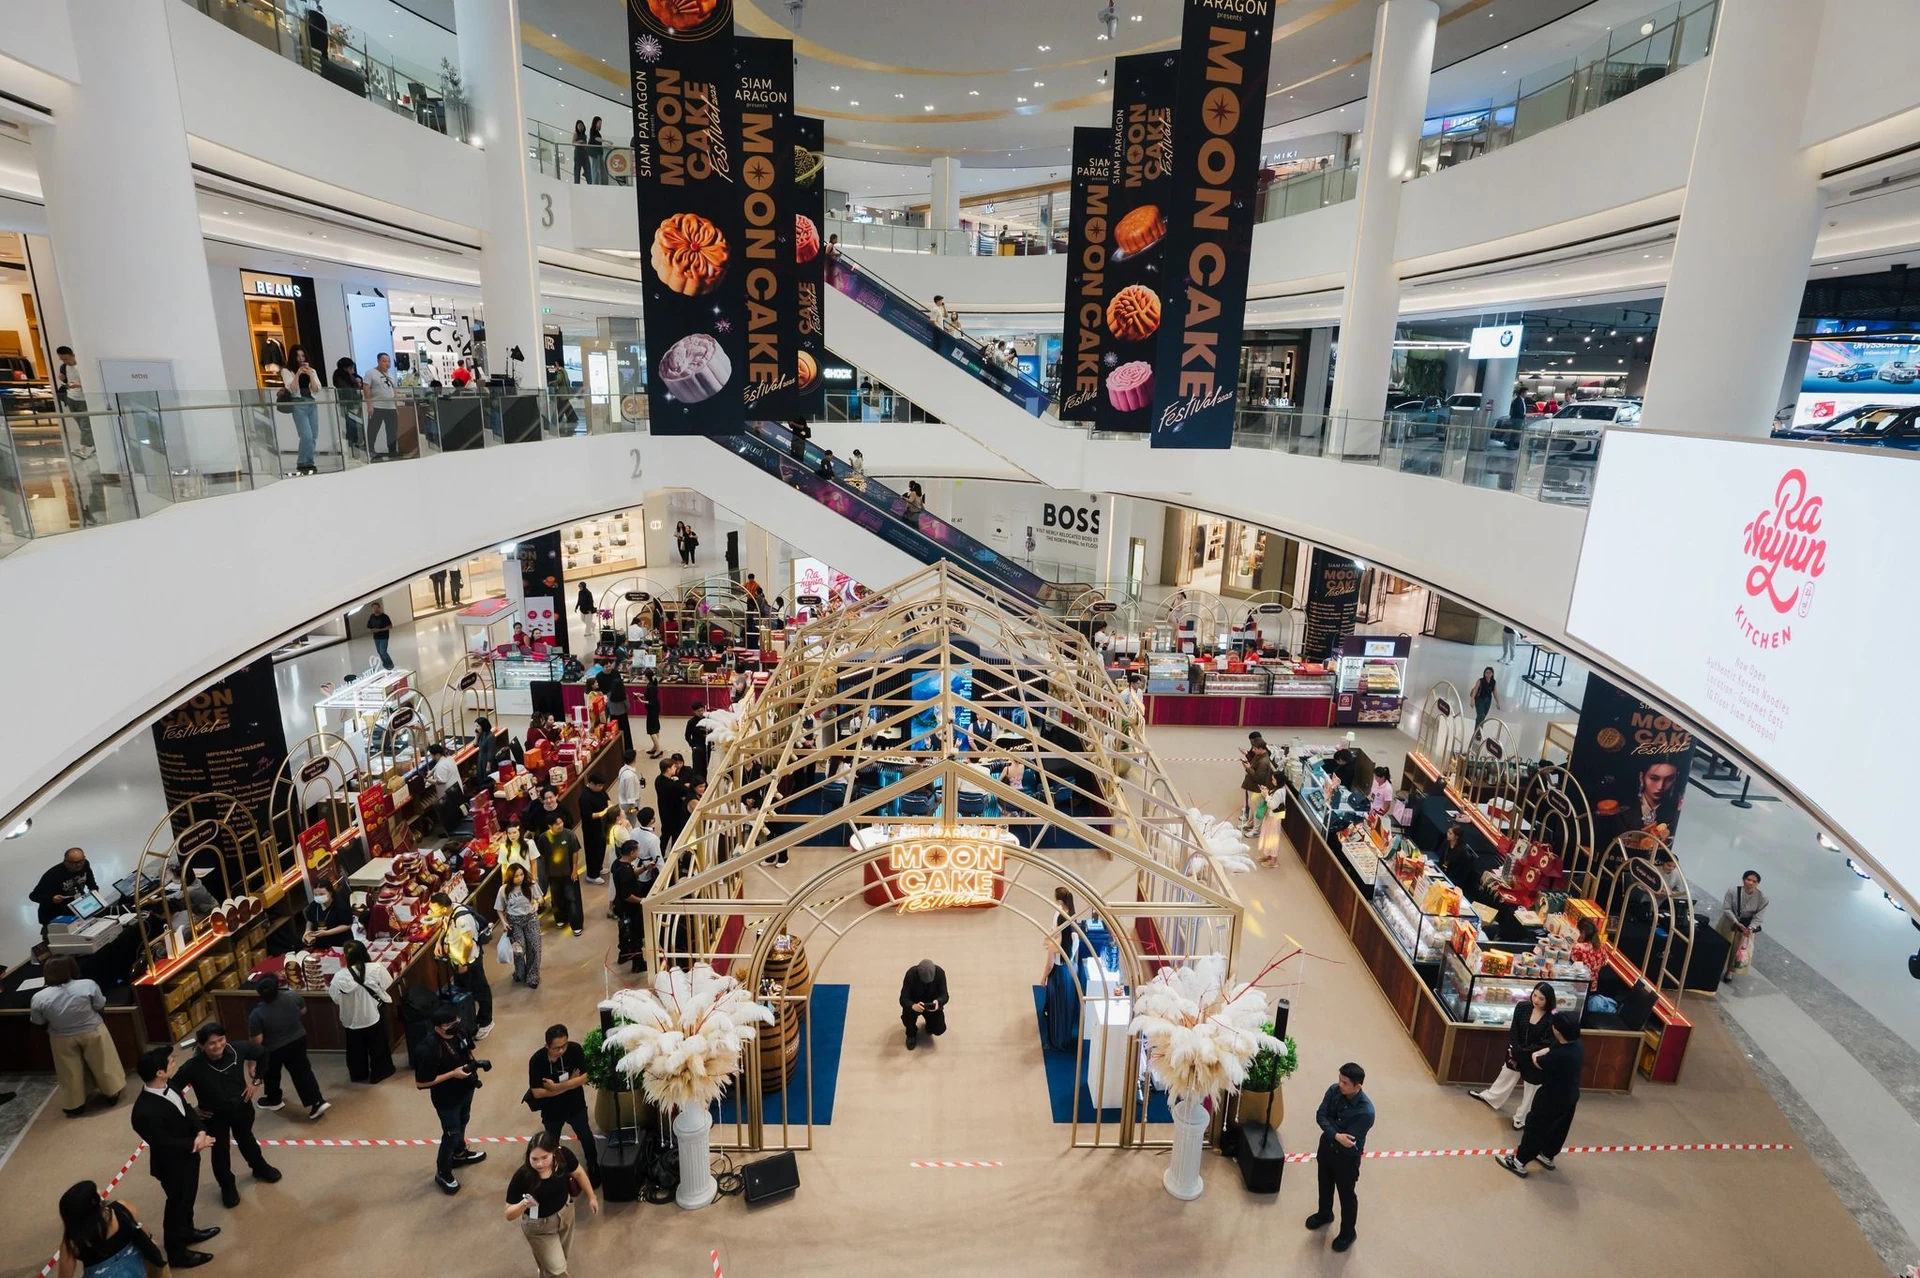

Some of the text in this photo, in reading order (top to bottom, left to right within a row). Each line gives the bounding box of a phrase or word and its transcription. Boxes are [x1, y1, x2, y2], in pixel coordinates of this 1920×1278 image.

[1216, 12, 1242, 22] presents
[735, 89, 787, 103] ARAGON
[741, 77, 772, 89] SIAM
[636, 70, 652, 178] SIAM PARAGON
[656, 68, 685, 186] MOON
[684, 81, 712, 180] CAKE
[1114, 109, 1124, 158] PARAGON
[700, 94, 733, 183] Festival
[1125, 104, 1147, 187] MOON
[1144, 108, 1166, 180] CAKE
[1077, 166, 1109, 177] PARAG
[1089, 158, 1110, 167] SIAM
[1112, 158, 1121, 184] SIAM
[540, 193, 554, 227] 3
[1178, 26, 1247, 398] MOON CAKE
[742, 113, 779, 383] MOON CAKE
[1081, 184, 1109, 296] MOON
[256, 280, 302, 297] BEAMS
[1076, 302, 1102, 392] CAKE
[1064, 386, 1098, 412] Festiva
[1158, 386, 1222, 433] Festival
[630, 449, 642, 479] 2
[1774, 468, 1823, 534] Ra
[1044, 503, 1100, 535] BOSS
[1324, 570, 1360, 580] MOON
[1735, 604, 1791, 649] KITCHEN
[178, 688, 233, 710] ON
[1761, 689, 1790, 715] Noodles
[162, 718, 220, 741] Festival
[1631, 712, 1683, 732] MO
[1631, 741, 1686, 756] Festival
[1634, 729, 1693, 748] CAKE
[890, 844, 1003, 871] MOON
[900, 870, 994, 895] CAKE
